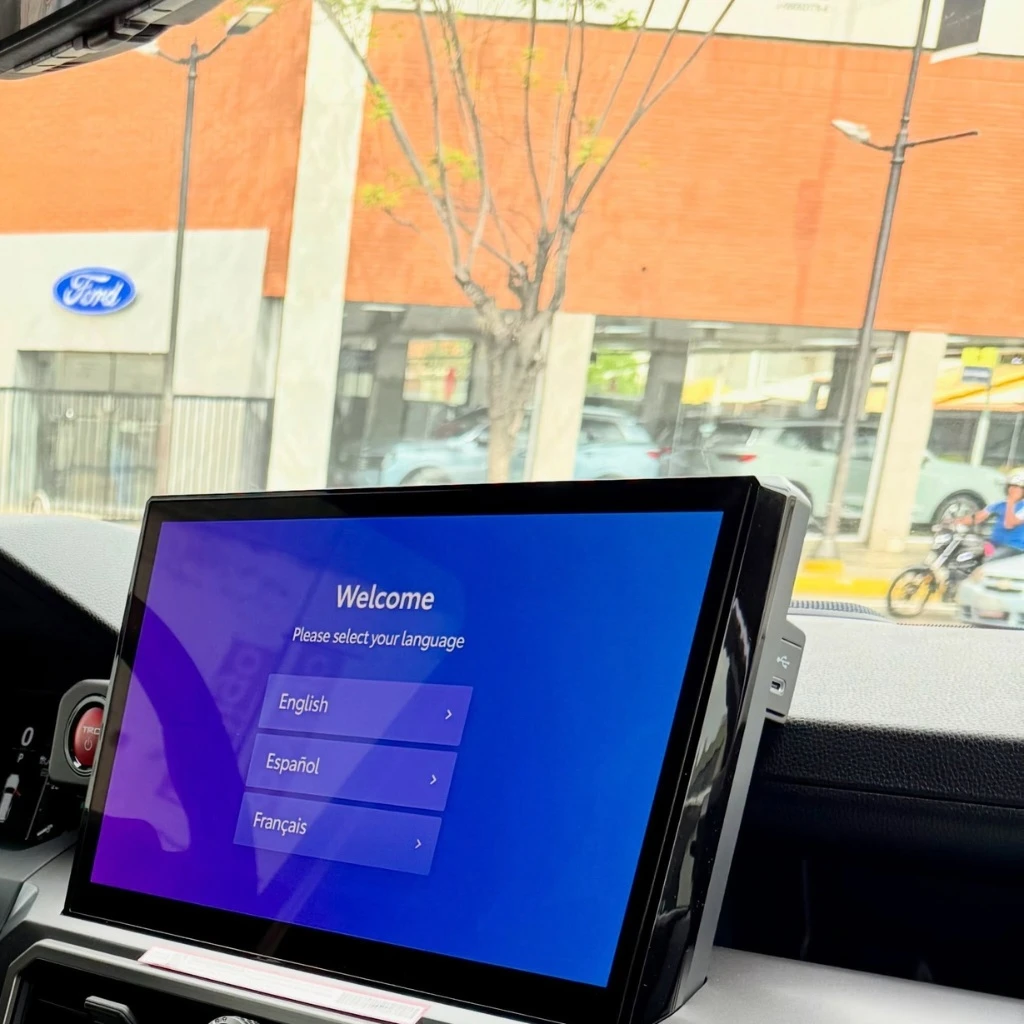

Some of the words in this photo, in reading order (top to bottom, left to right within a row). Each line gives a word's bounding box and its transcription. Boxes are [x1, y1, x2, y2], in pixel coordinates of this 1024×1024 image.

[61, 274, 126, 309] Ford
[336, 584, 435, 611] Welcome
[292, 626, 331, 644] Please
[332, 628, 369, 646] select
[369, 631, 400, 649] your
[401, 630, 465, 652] language
[278, 692, 329, 716] English
[265, 752, 320, 775] Español
[253, 811, 307, 836] Français
